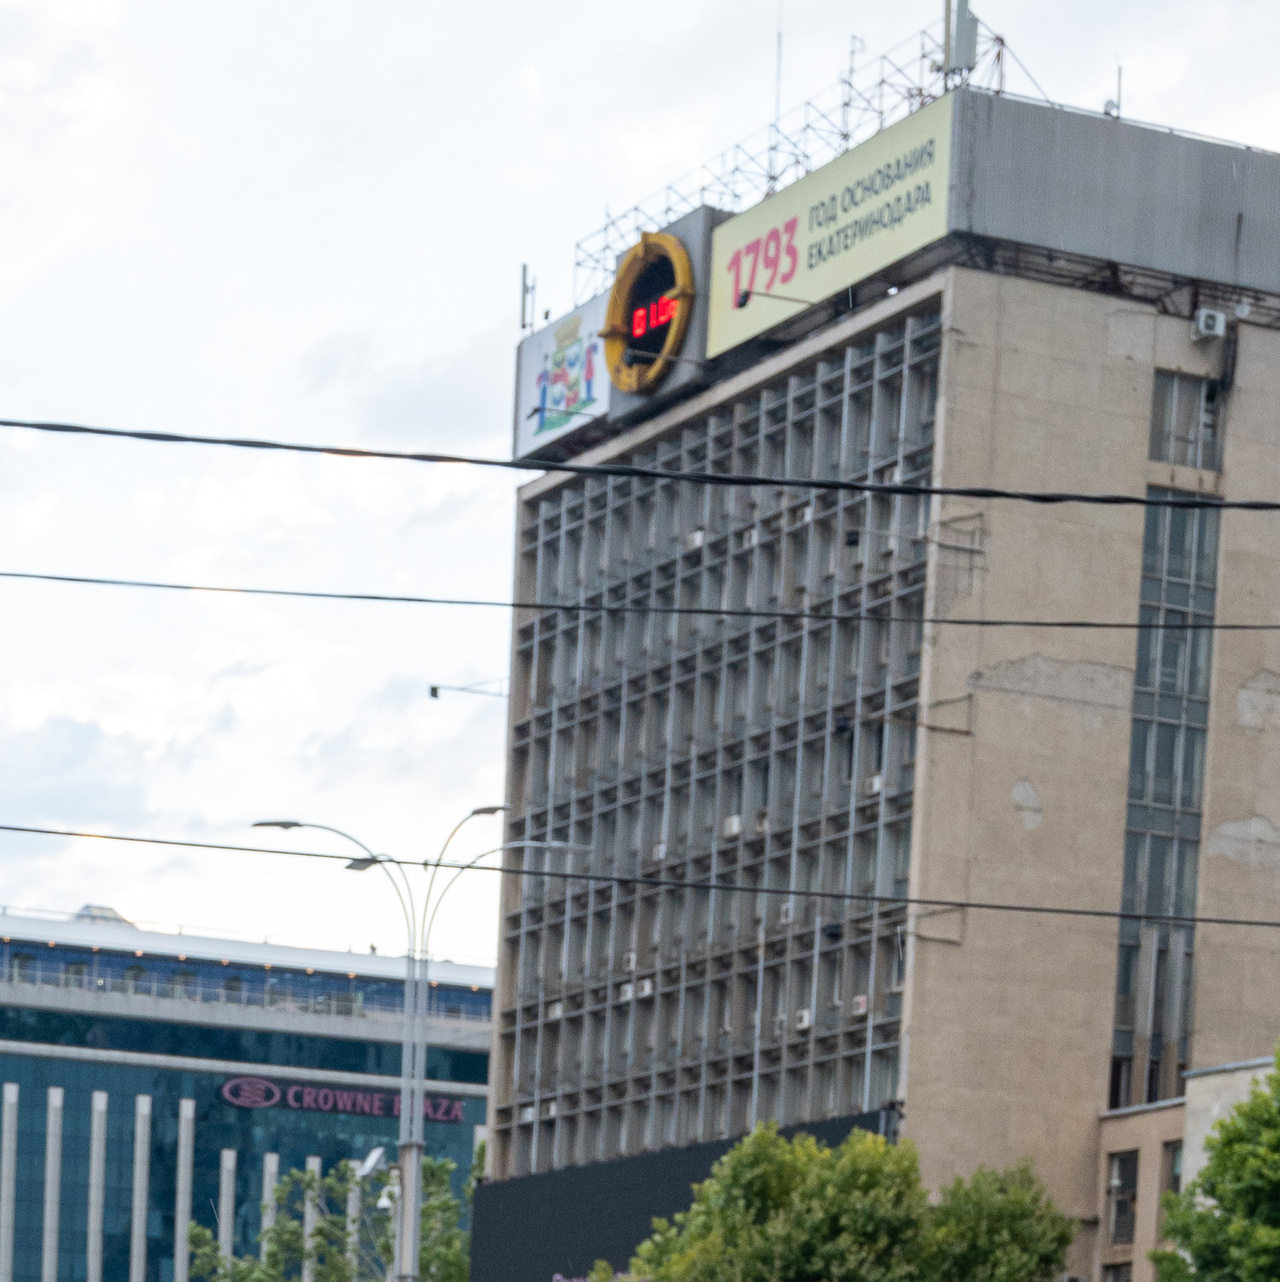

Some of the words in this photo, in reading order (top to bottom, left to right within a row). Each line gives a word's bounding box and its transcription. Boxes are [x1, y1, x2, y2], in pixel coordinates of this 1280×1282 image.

[807, 180, 932, 270] ЕКАТЕРИНОДАРА
[808, 193, 838, 232] ГОД
[840, 138, 936, 213] ОСНОВАНИЯ
[727, 215, 800, 310] 1793
[287, 1085, 384, 1116] CROWNE
